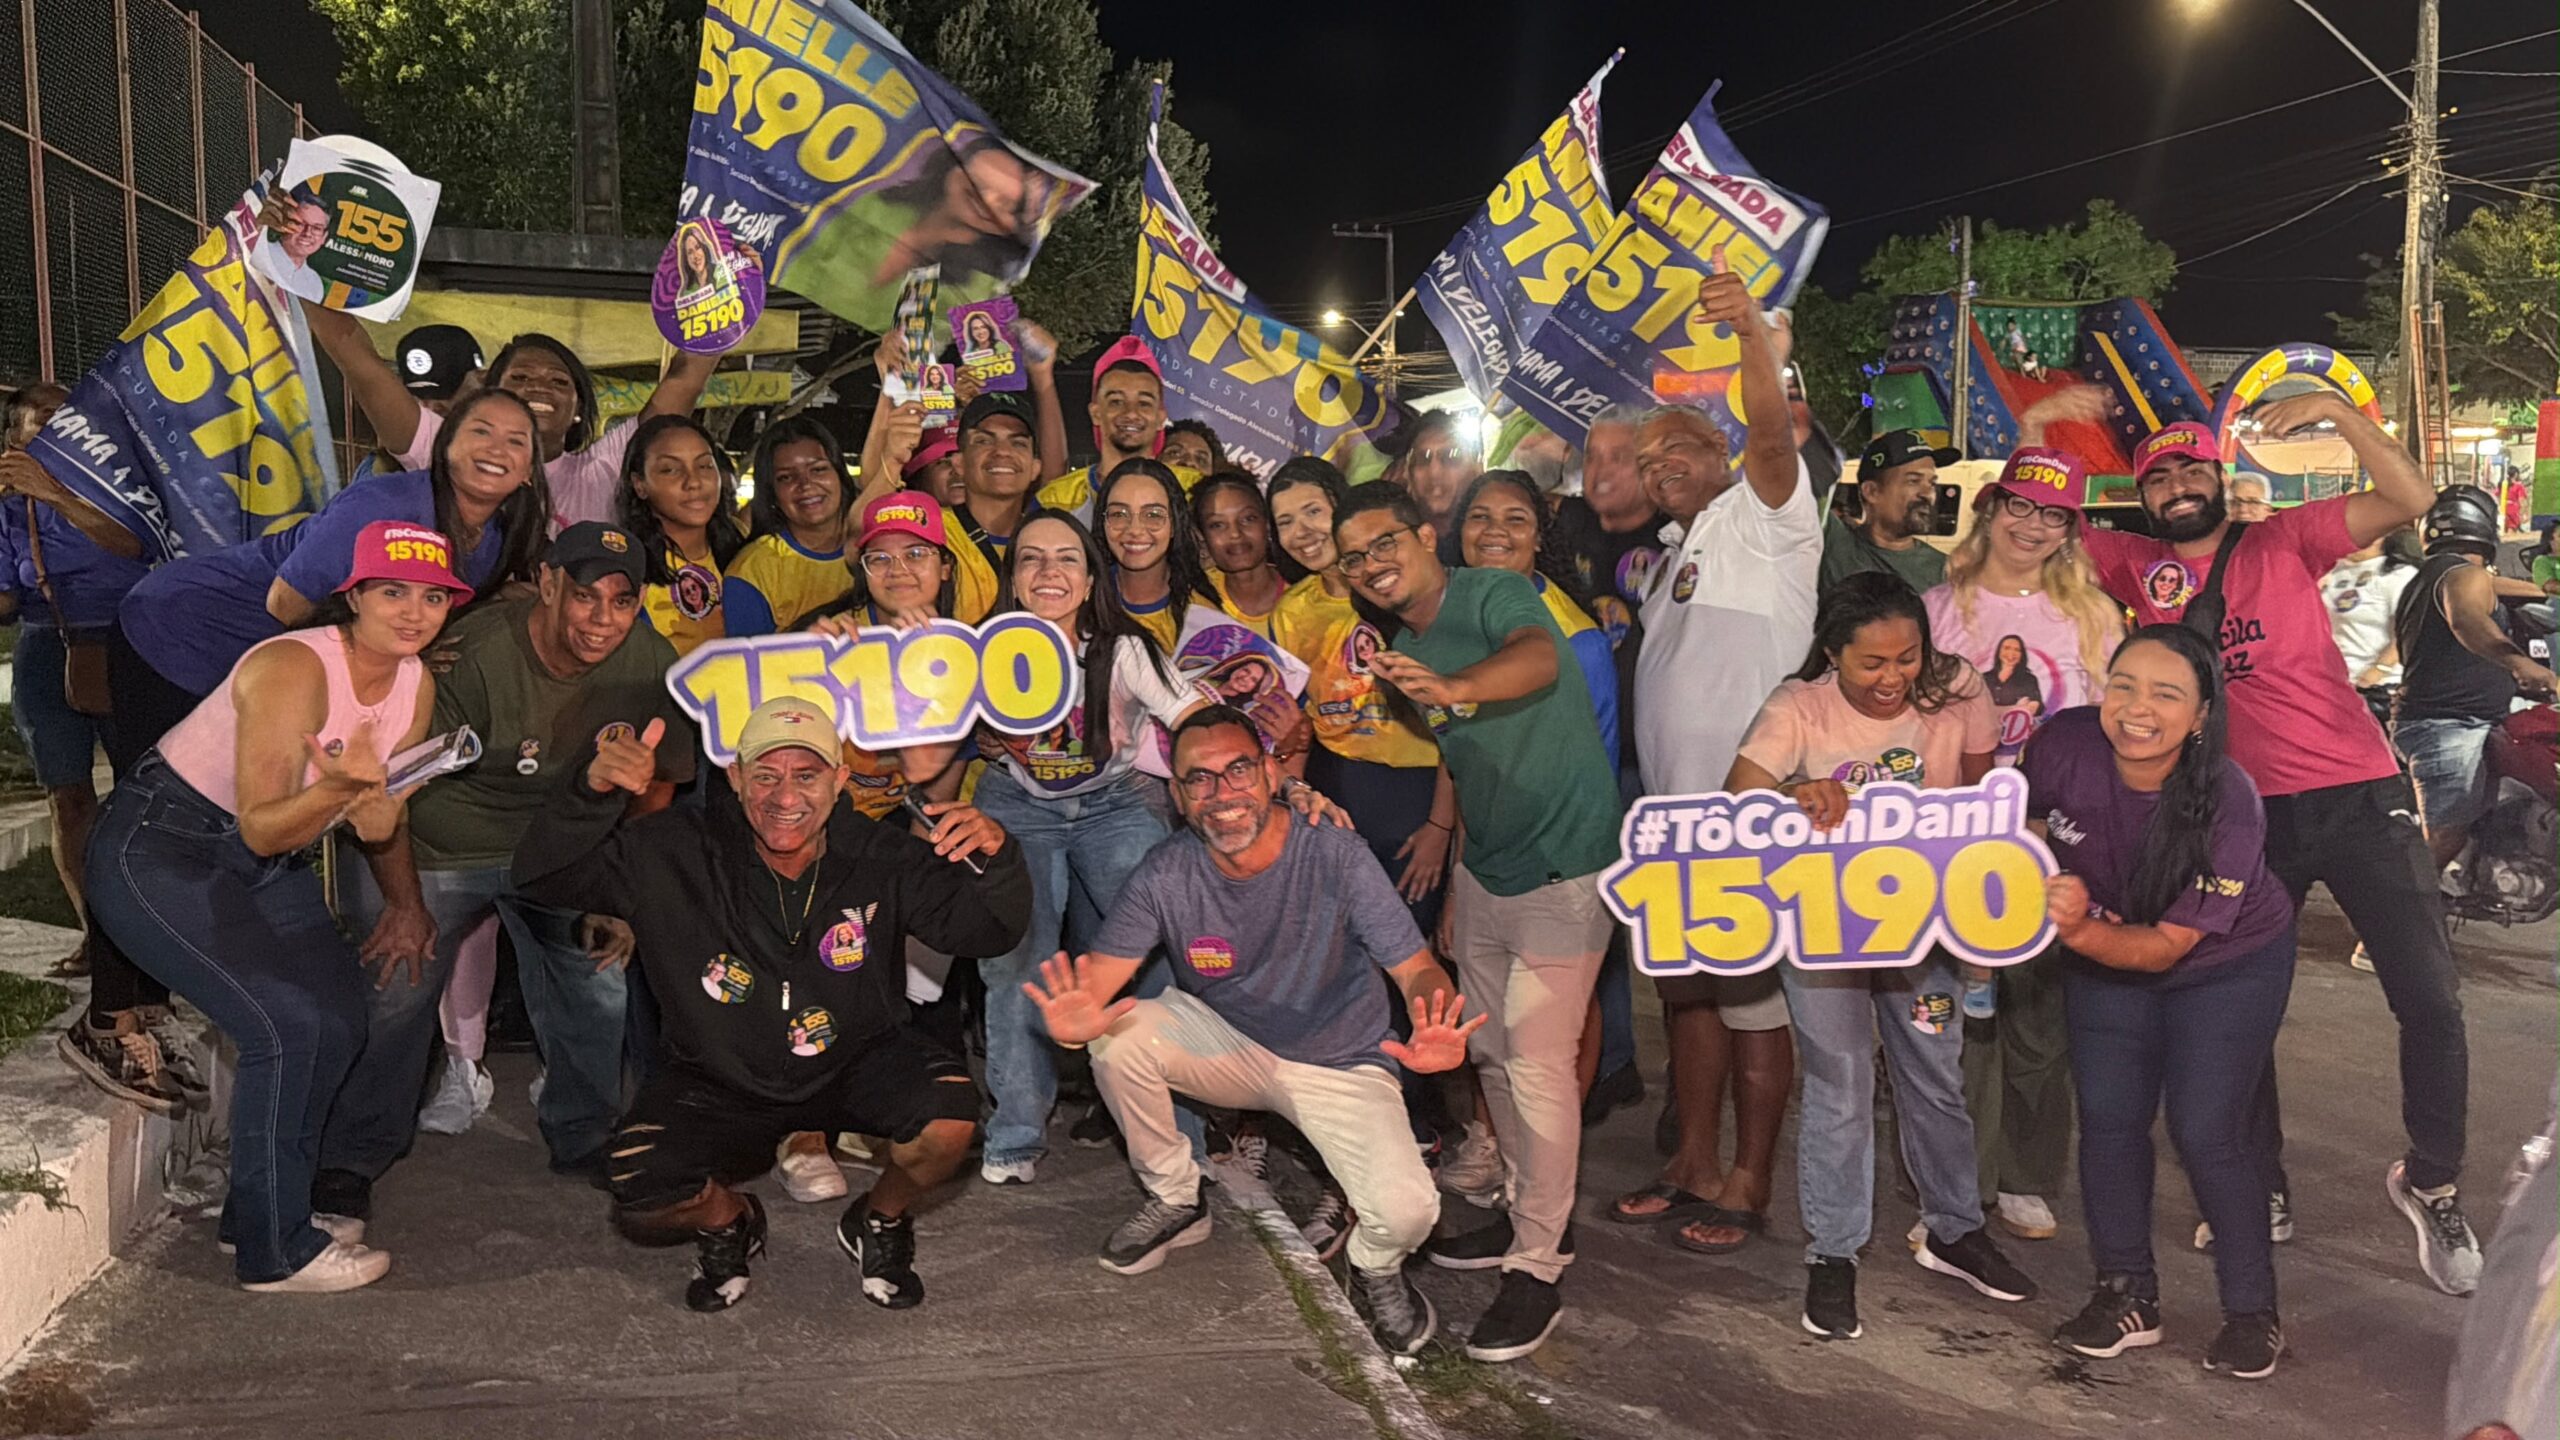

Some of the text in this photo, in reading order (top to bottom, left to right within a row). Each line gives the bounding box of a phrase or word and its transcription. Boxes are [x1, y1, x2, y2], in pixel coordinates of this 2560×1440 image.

[693, 17, 887, 183] 5190
[336, 200, 408, 252] 155
[1487, 154, 1591, 306] 519
[325, 239, 396, 269] ALESSANDRO
[679, 298, 745, 340] 15190
[1189, 391, 1215, 409] Senador
[1214, 404, 1247, 425] Delegado
[1246, 420, 1287, 446] Alessandro
[1208, 376, 1322, 445] ESTADUAL
[2014, 464, 2068, 491] 15190
[384, 540, 448, 569] 15190
[685, 626, 1062, 750] 15190
[1032, 763, 1096, 780] 15190
[1612, 840, 2049, 962] 15190
